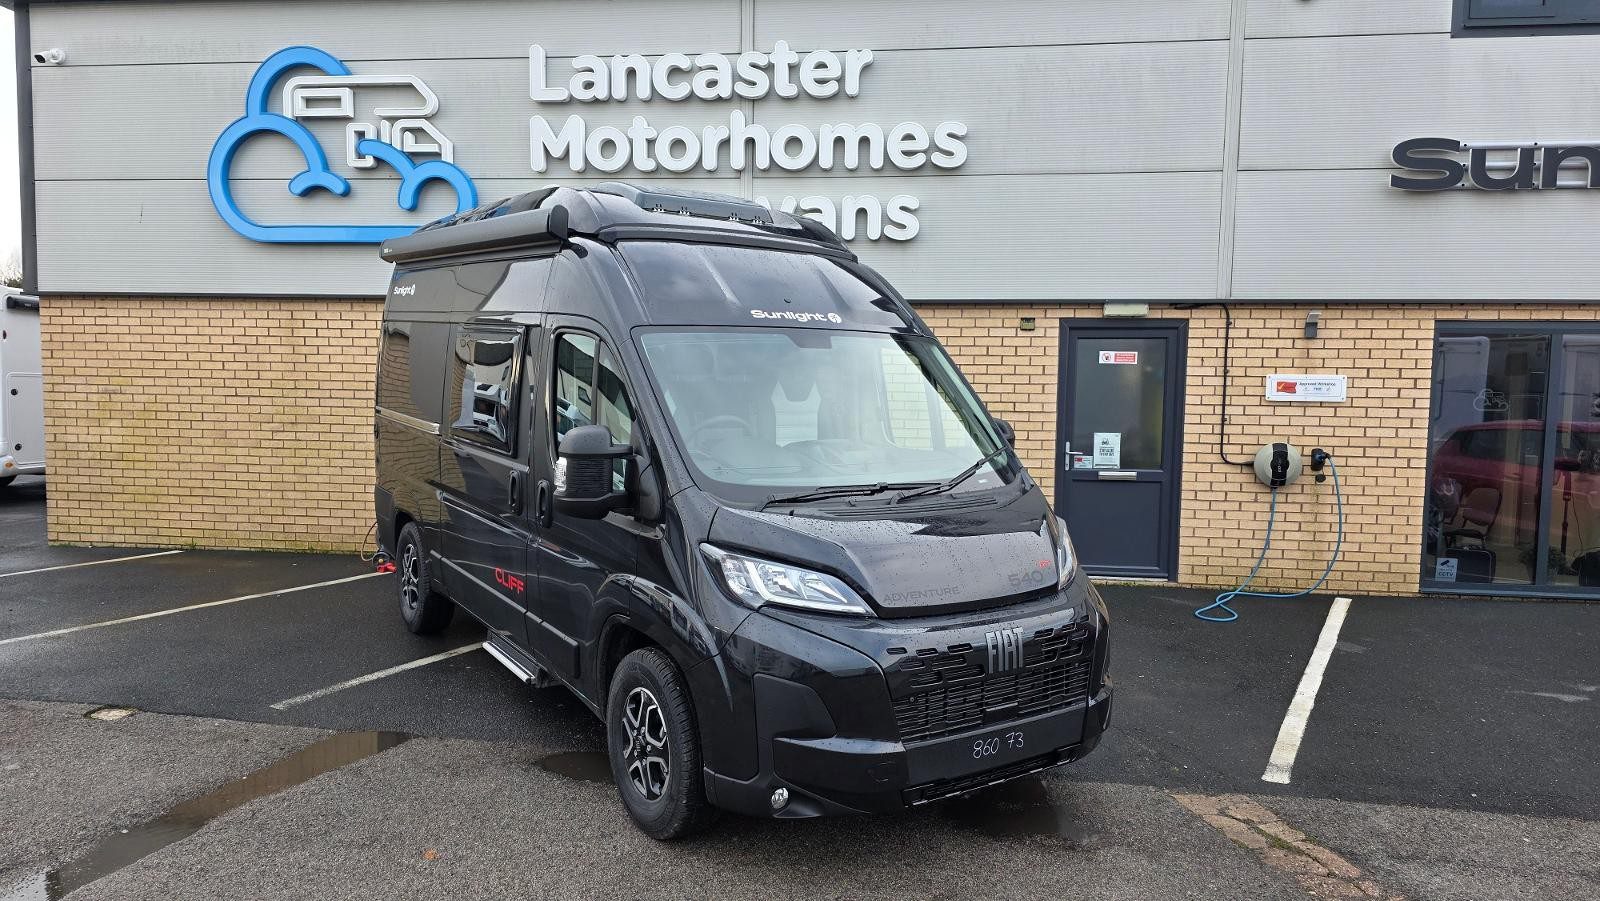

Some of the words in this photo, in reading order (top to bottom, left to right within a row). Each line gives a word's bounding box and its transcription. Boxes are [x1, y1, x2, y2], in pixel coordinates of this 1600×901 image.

[529, 40, 874, 102] Lancaster
[529, 109, 968, 173] Motorhomes
[1389, 137, 1600, 191] Sun
[393, 285, 411, 297] Sunlight
[750, 309, 828, 323] Sunlight
[495, 567, 524, 594] CLIFF
[1008, 570, 1044, 587] 540
[884, 586, 961, 603] ADVENTURE
[985, 627, 1023, 674] FIAT
[973, 737, 999, 758] 860
[1005, 731, 1024, 749] 73
